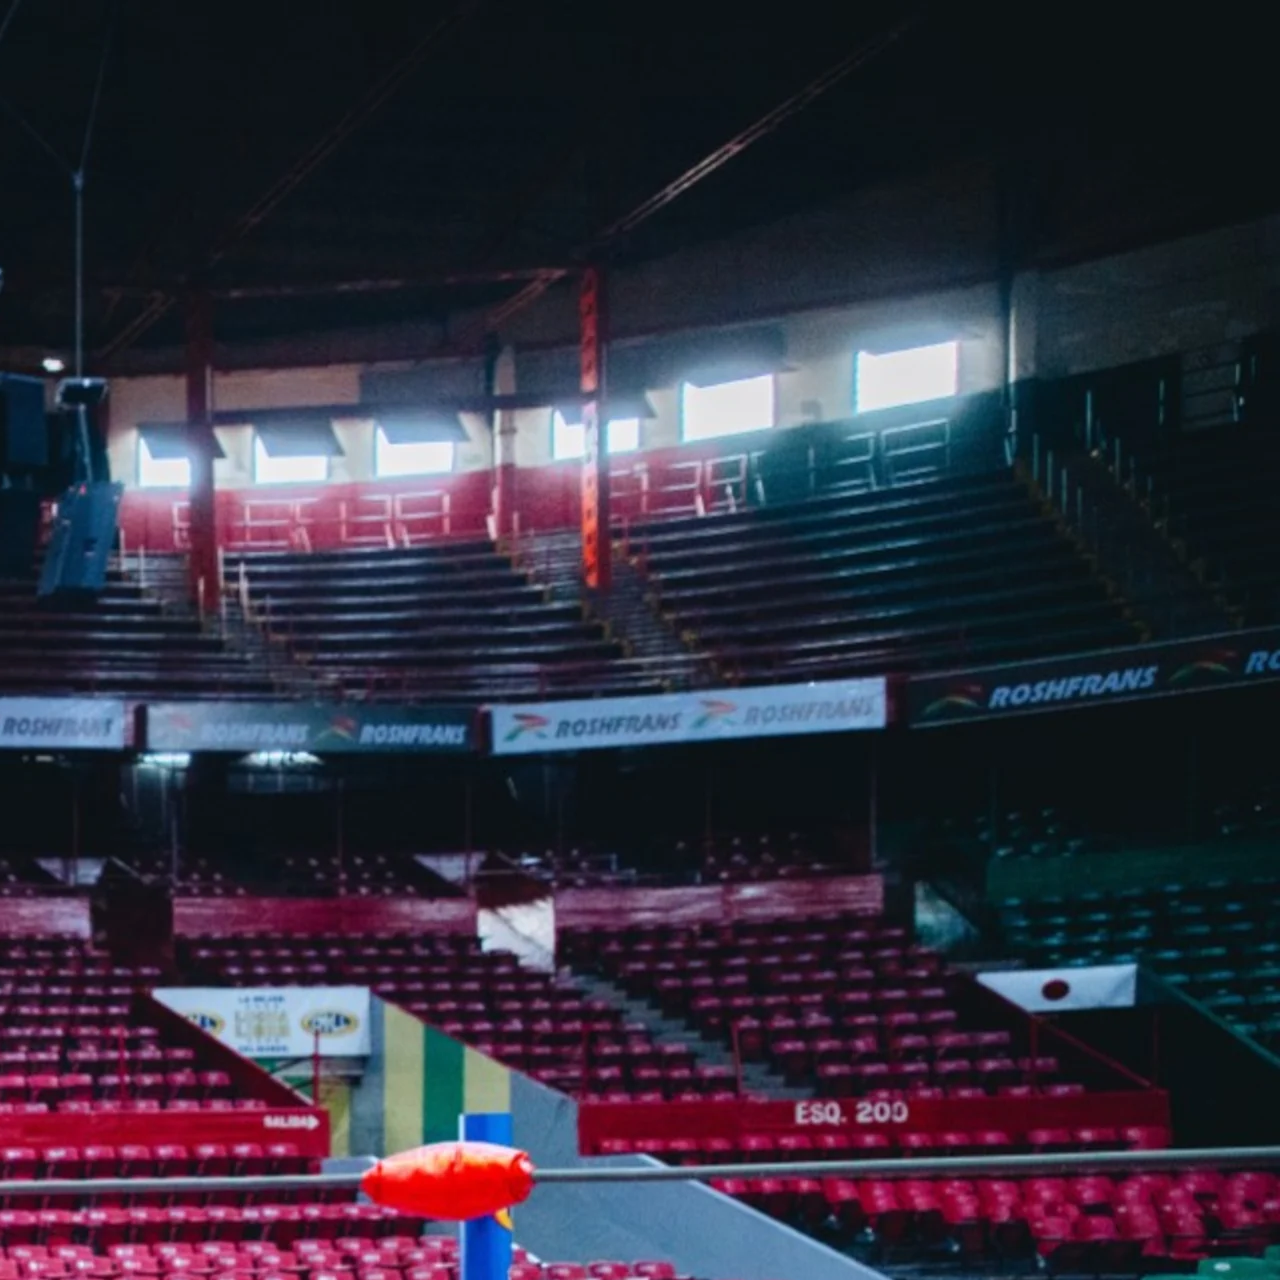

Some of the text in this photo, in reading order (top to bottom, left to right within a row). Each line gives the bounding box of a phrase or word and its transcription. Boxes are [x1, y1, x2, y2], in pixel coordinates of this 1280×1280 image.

[989, 666, 1159, 709] ROSHFRANS
[744, 695, 880, 726] ROSHFRANS
[2, 717, 114, 737] ROSHFRANS
[200, 723, 310, 744] ROSHFRANS
[358, 723, 468, 745] ROSHFRANS
[555, 711, 682, 740] ROSHFRANS
[795, 1102, 909, 1126] ESQ. 200
